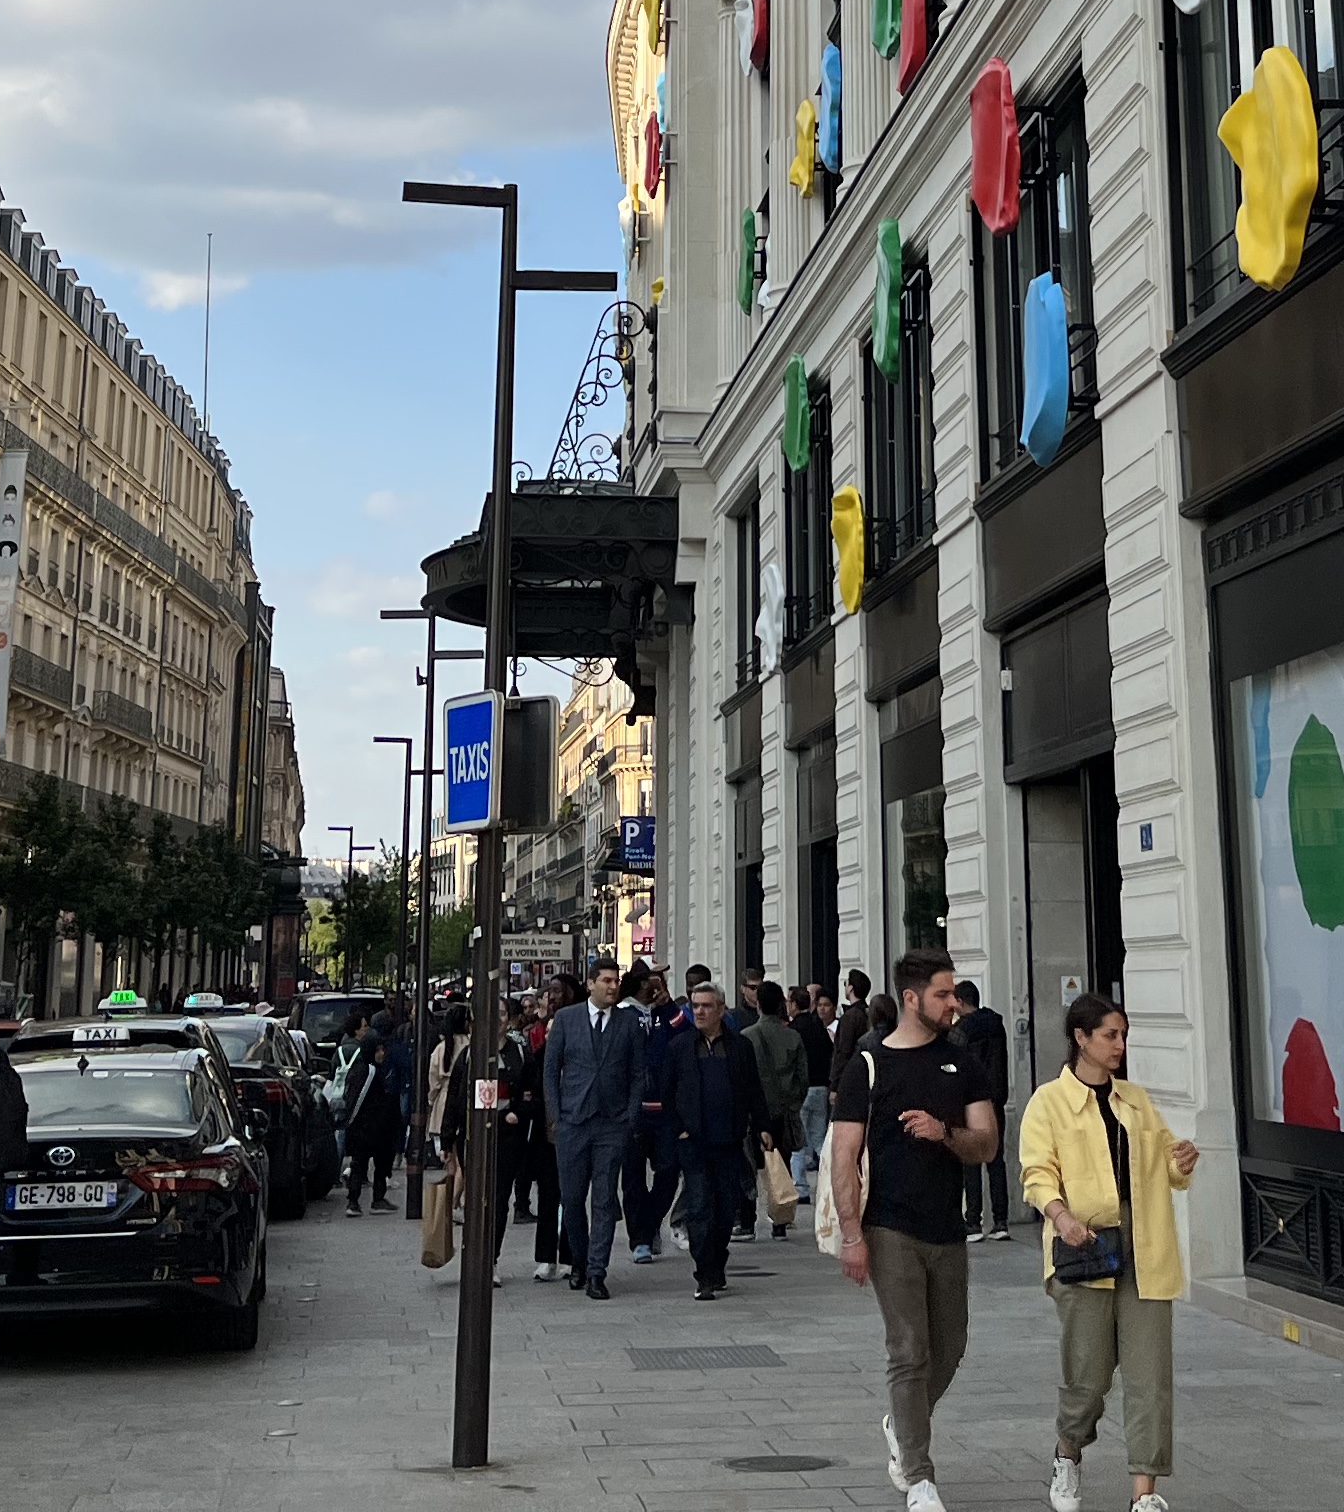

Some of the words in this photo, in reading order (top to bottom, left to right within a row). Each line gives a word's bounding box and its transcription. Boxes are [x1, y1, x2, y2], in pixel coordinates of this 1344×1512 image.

[449, 741, 490, 785] TAXIS
[625, 822, 640, 845] P
[515, 949, 538, 957] VOTRE
[114, 992, 133, 1002] TAXI
[85, 1028, 116, 1040] TAXI
